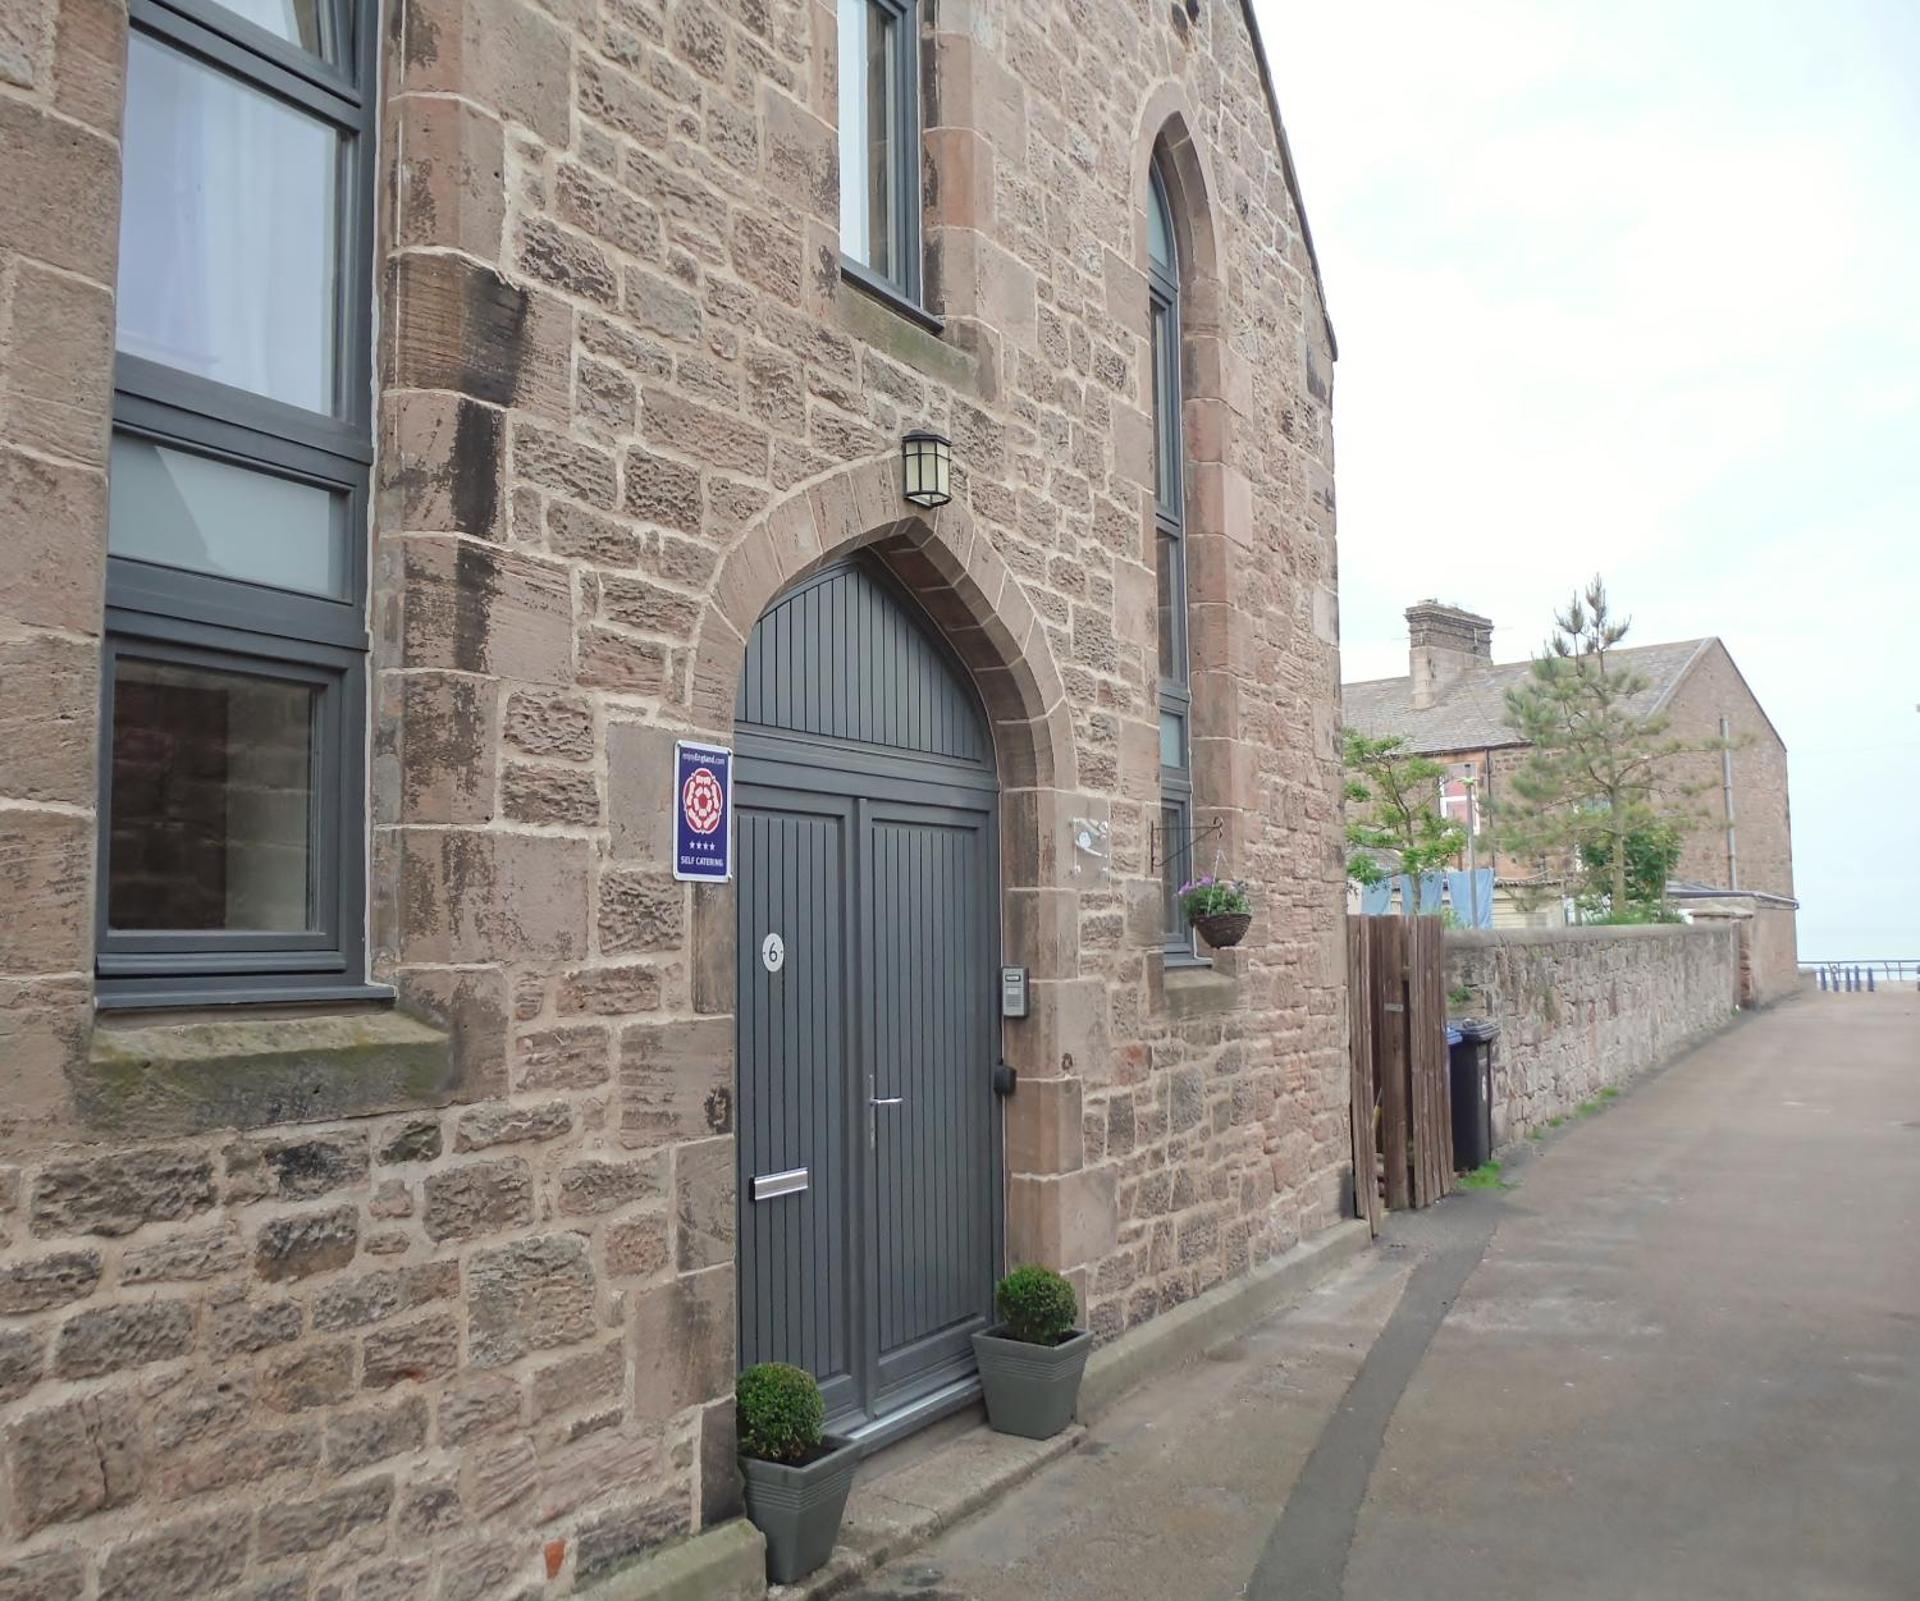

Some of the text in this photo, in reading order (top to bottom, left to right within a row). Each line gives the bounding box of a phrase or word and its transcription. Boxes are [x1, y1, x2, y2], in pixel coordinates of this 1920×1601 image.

[680, 855, 724, 867] SELF CATERING
[769, 942, 778, 962] 6
